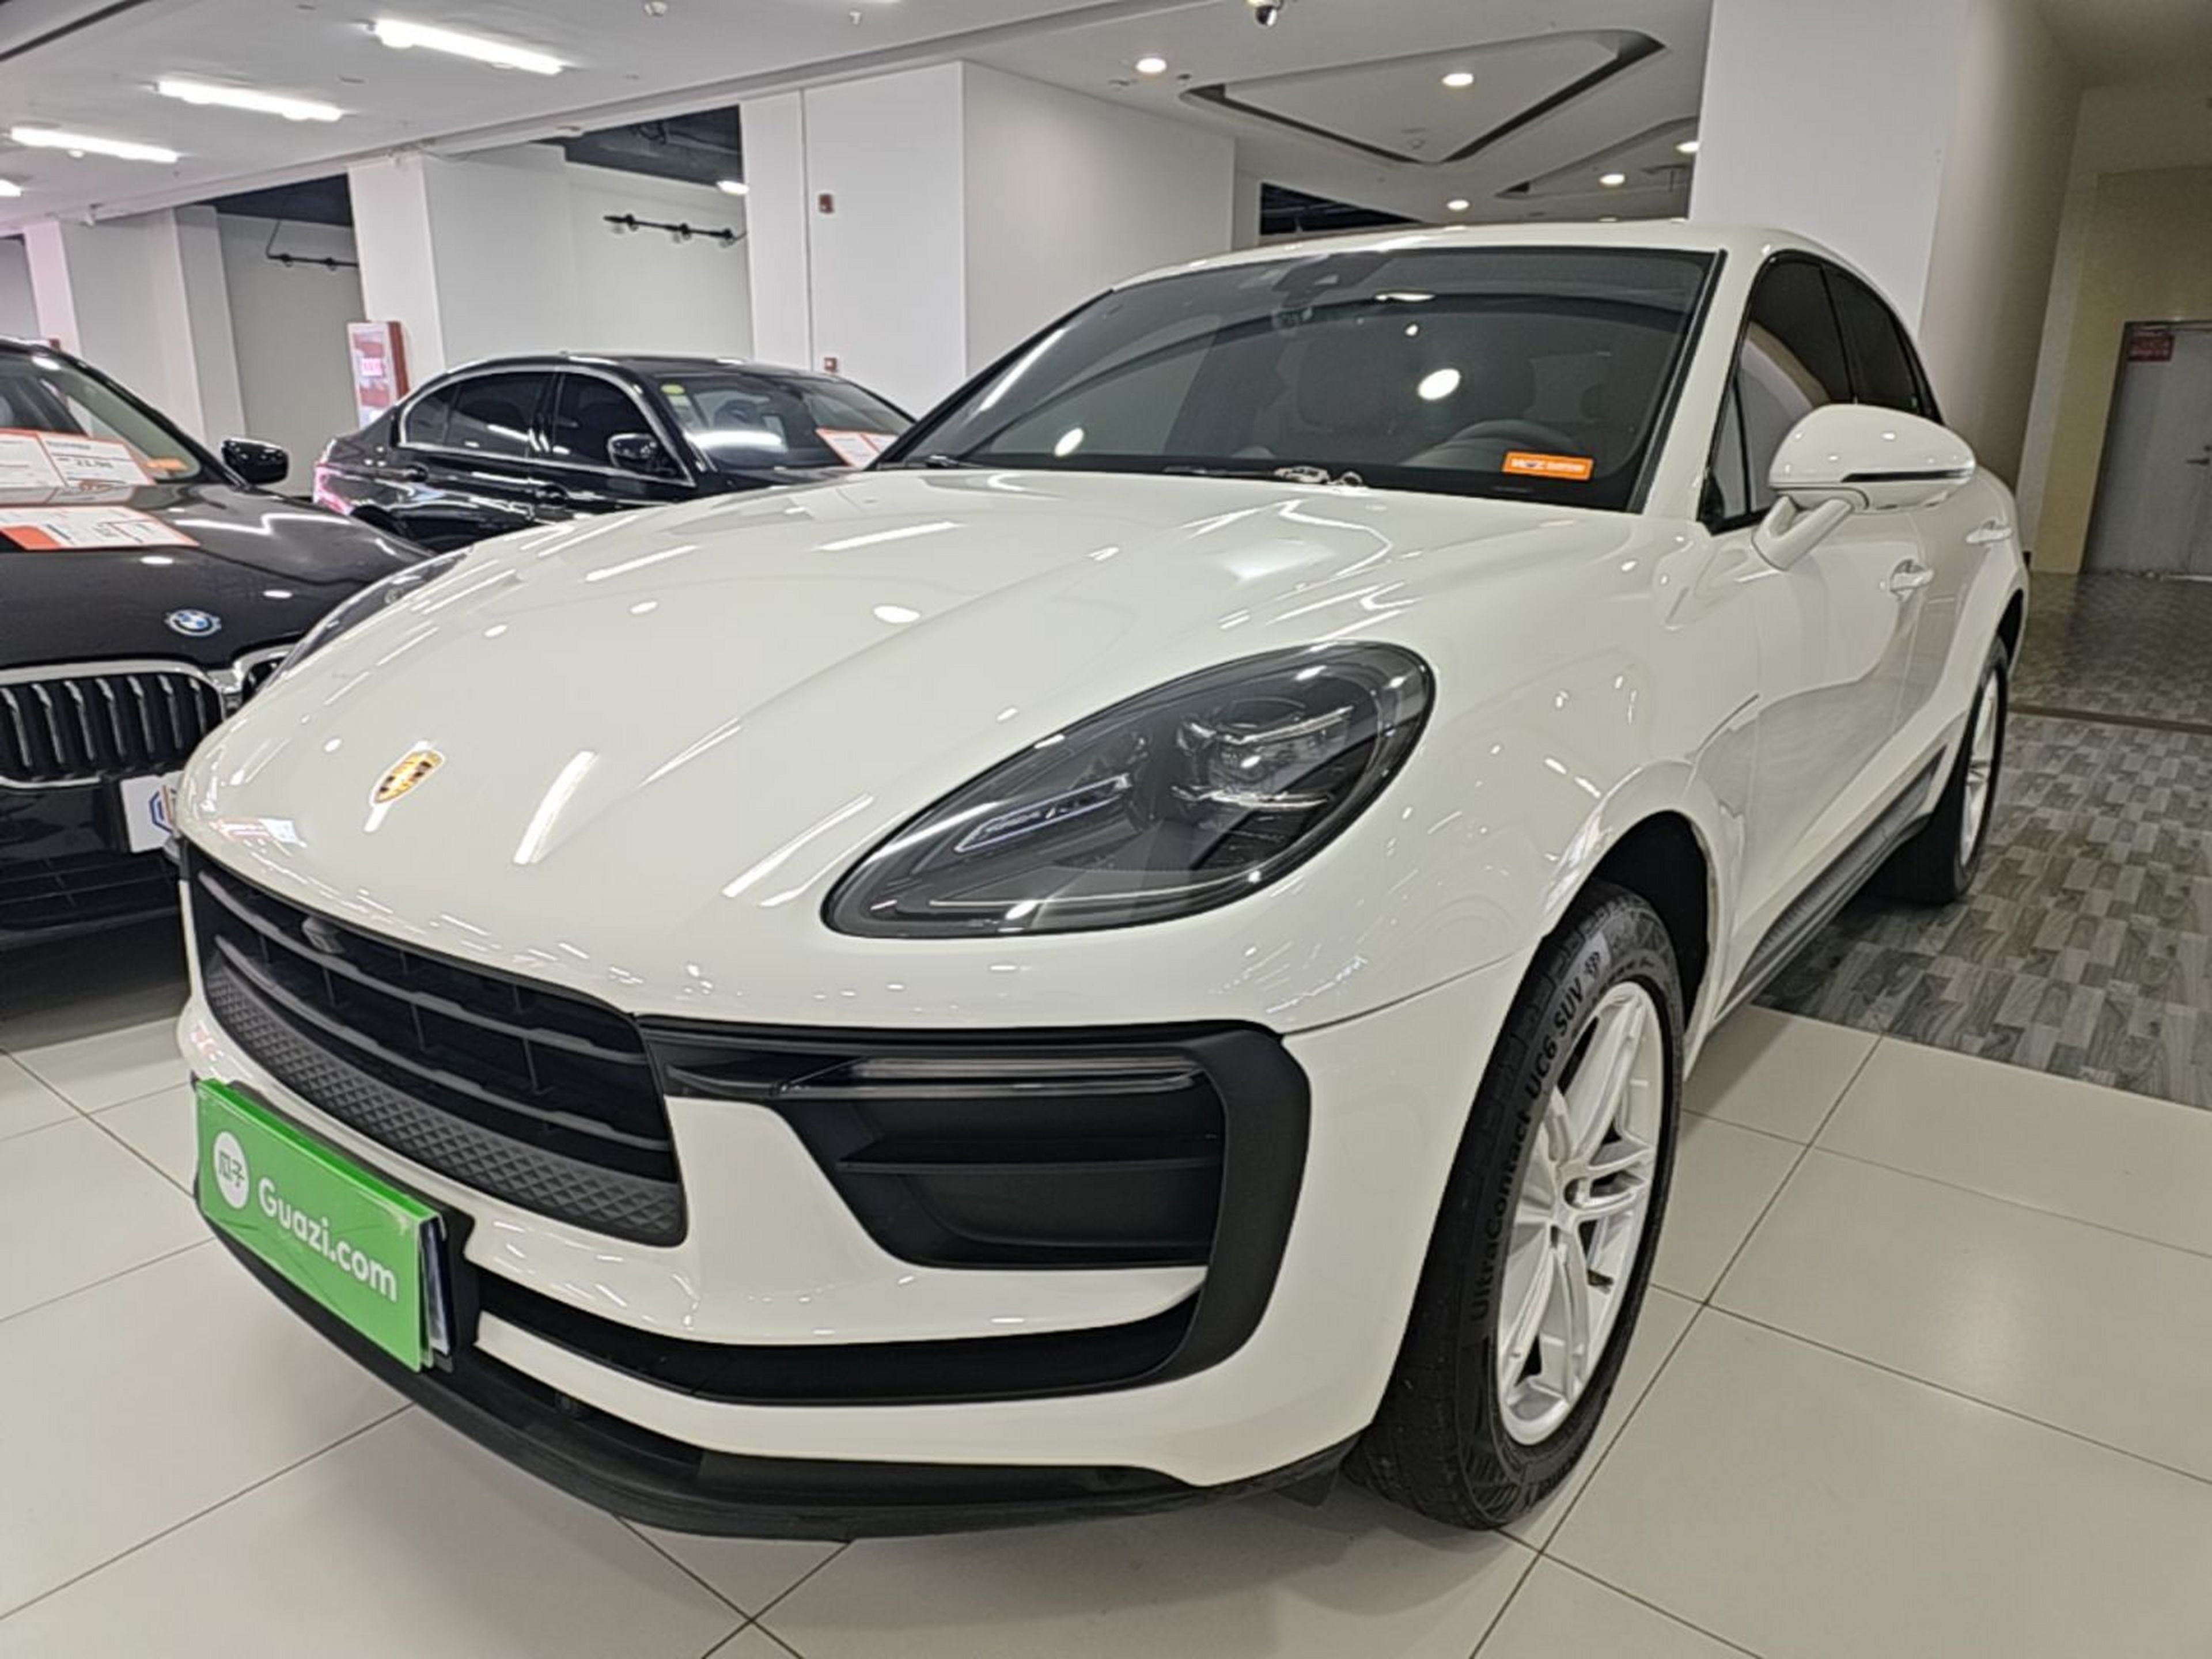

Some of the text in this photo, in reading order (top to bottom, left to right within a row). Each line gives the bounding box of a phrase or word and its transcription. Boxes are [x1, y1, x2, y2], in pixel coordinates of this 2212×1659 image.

[218, 1150, 245, 1188] 瓜子
[1471, 976, 1583, 1323] UltraContact UC6 SUV
[258, 1176, 398, 1304] Guazi.com
